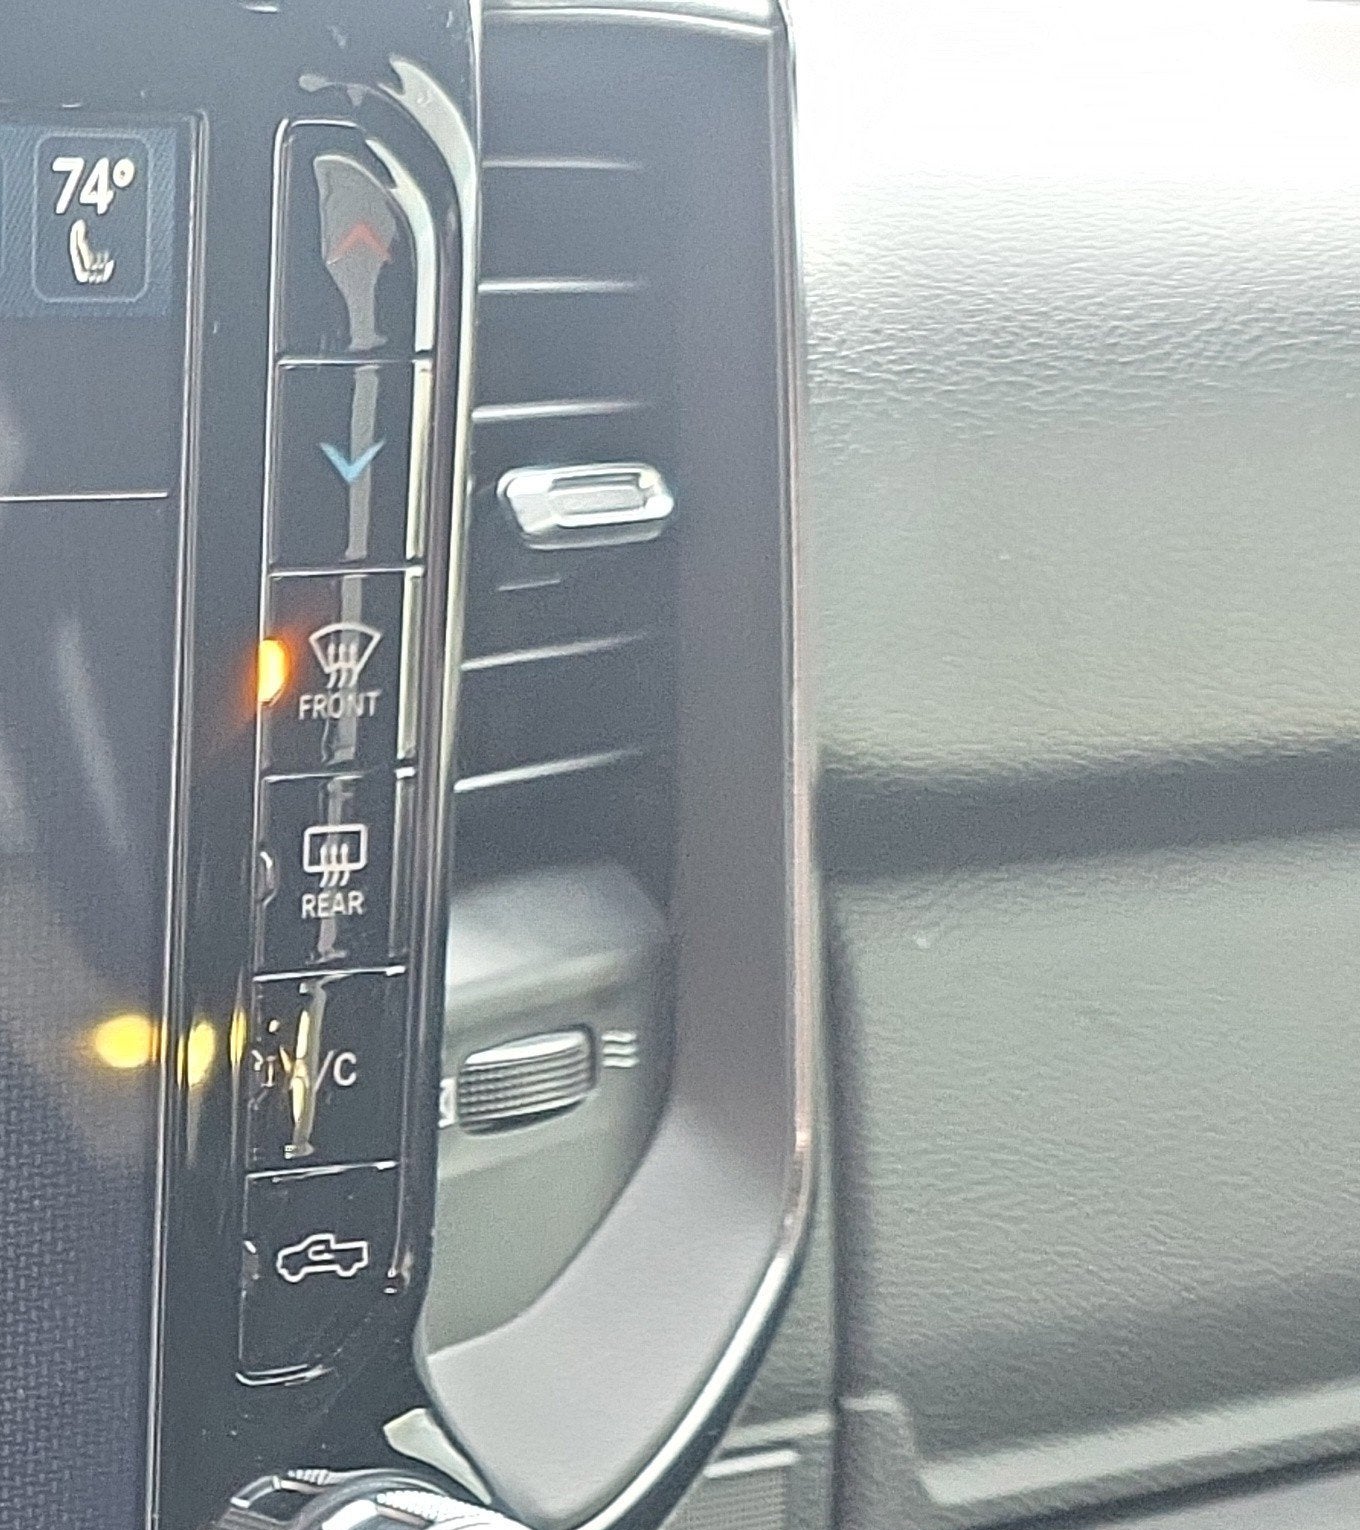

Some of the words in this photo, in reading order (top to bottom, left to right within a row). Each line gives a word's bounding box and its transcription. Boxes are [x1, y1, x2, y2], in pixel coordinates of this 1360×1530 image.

[53, 158, 135, 214] 74°
[298, 693, 380, 721] FRONT
[301, 893, 364, 917] REAR
